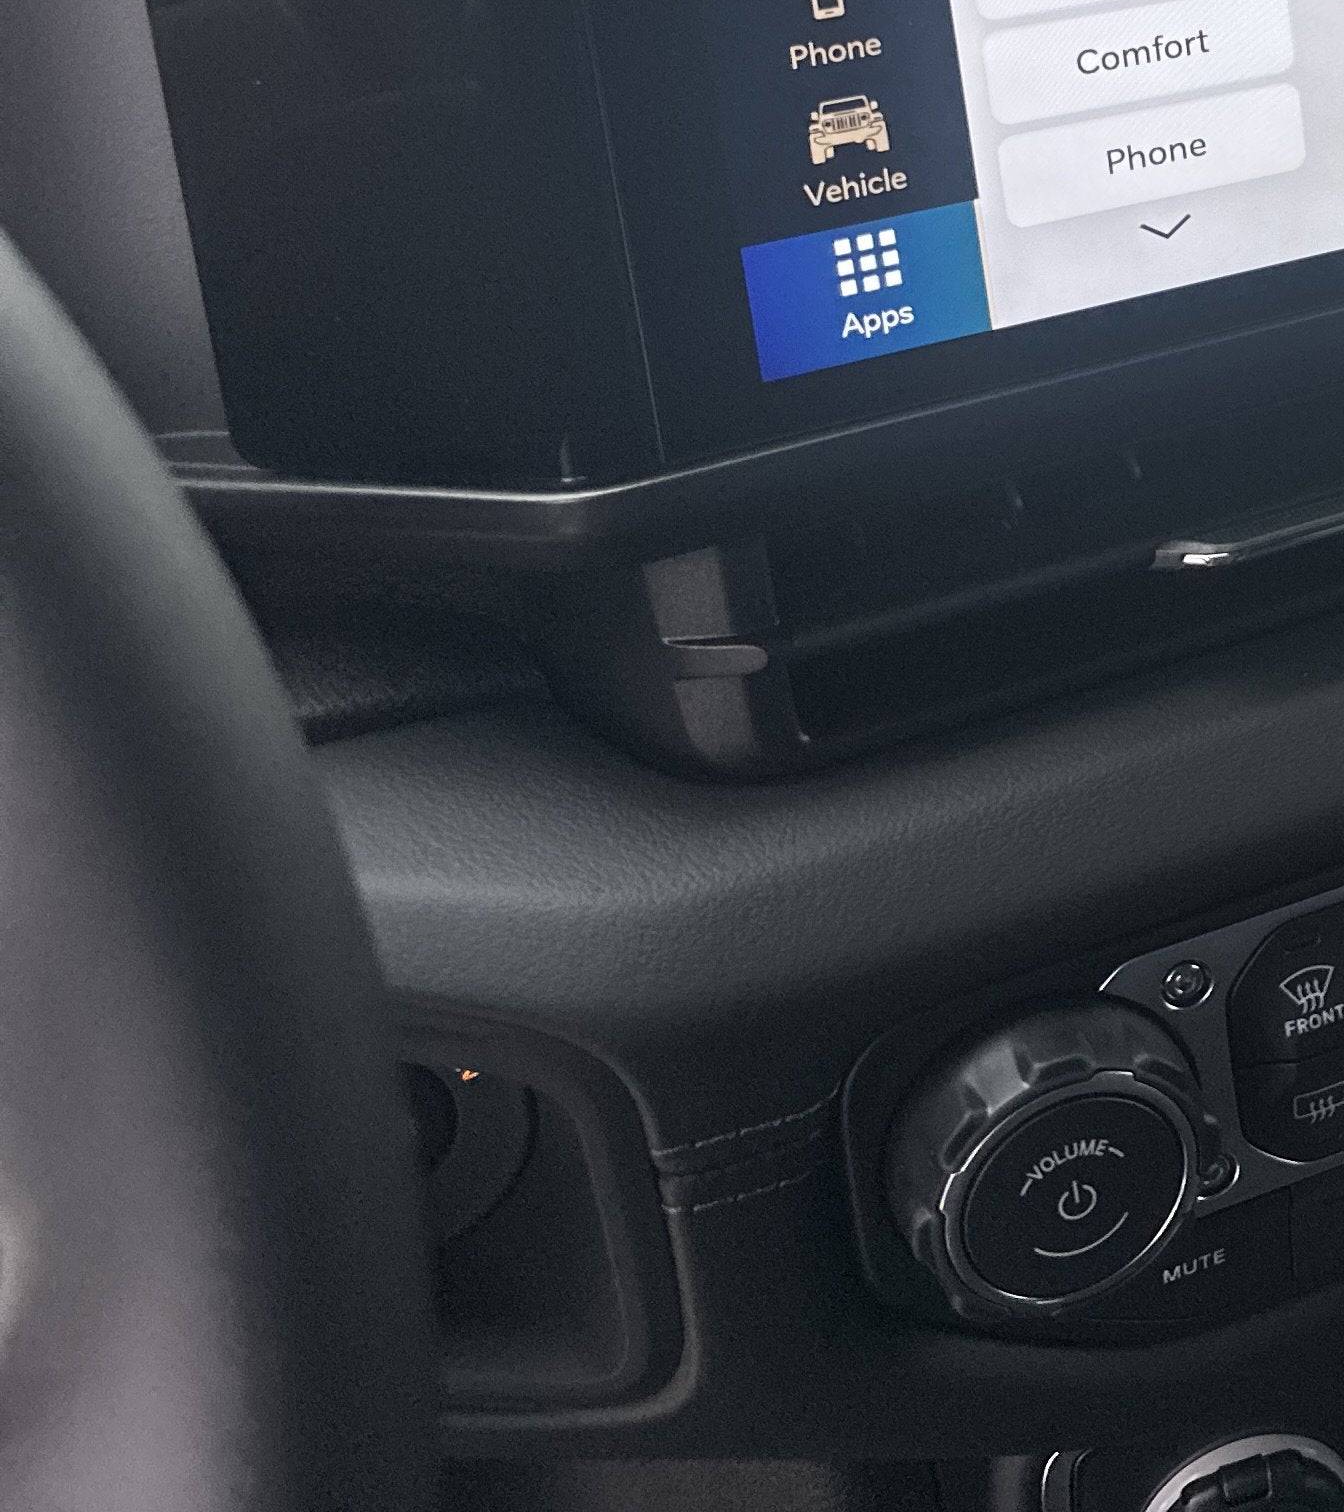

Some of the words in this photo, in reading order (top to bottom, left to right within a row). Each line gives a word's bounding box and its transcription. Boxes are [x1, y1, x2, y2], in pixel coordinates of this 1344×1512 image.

[788, 34, 883, 71] Phone
[1076, 28, 1210, 76] Comfort
[1105, 135, 1208, 176] Phone
[803, 166, 909, 208] Vehicle
[841, 303, 915, 339] Apps
[1026, 1138, 1110, 1182] VOLUME
[1161, 1248, 1228, 1284] MUTE
